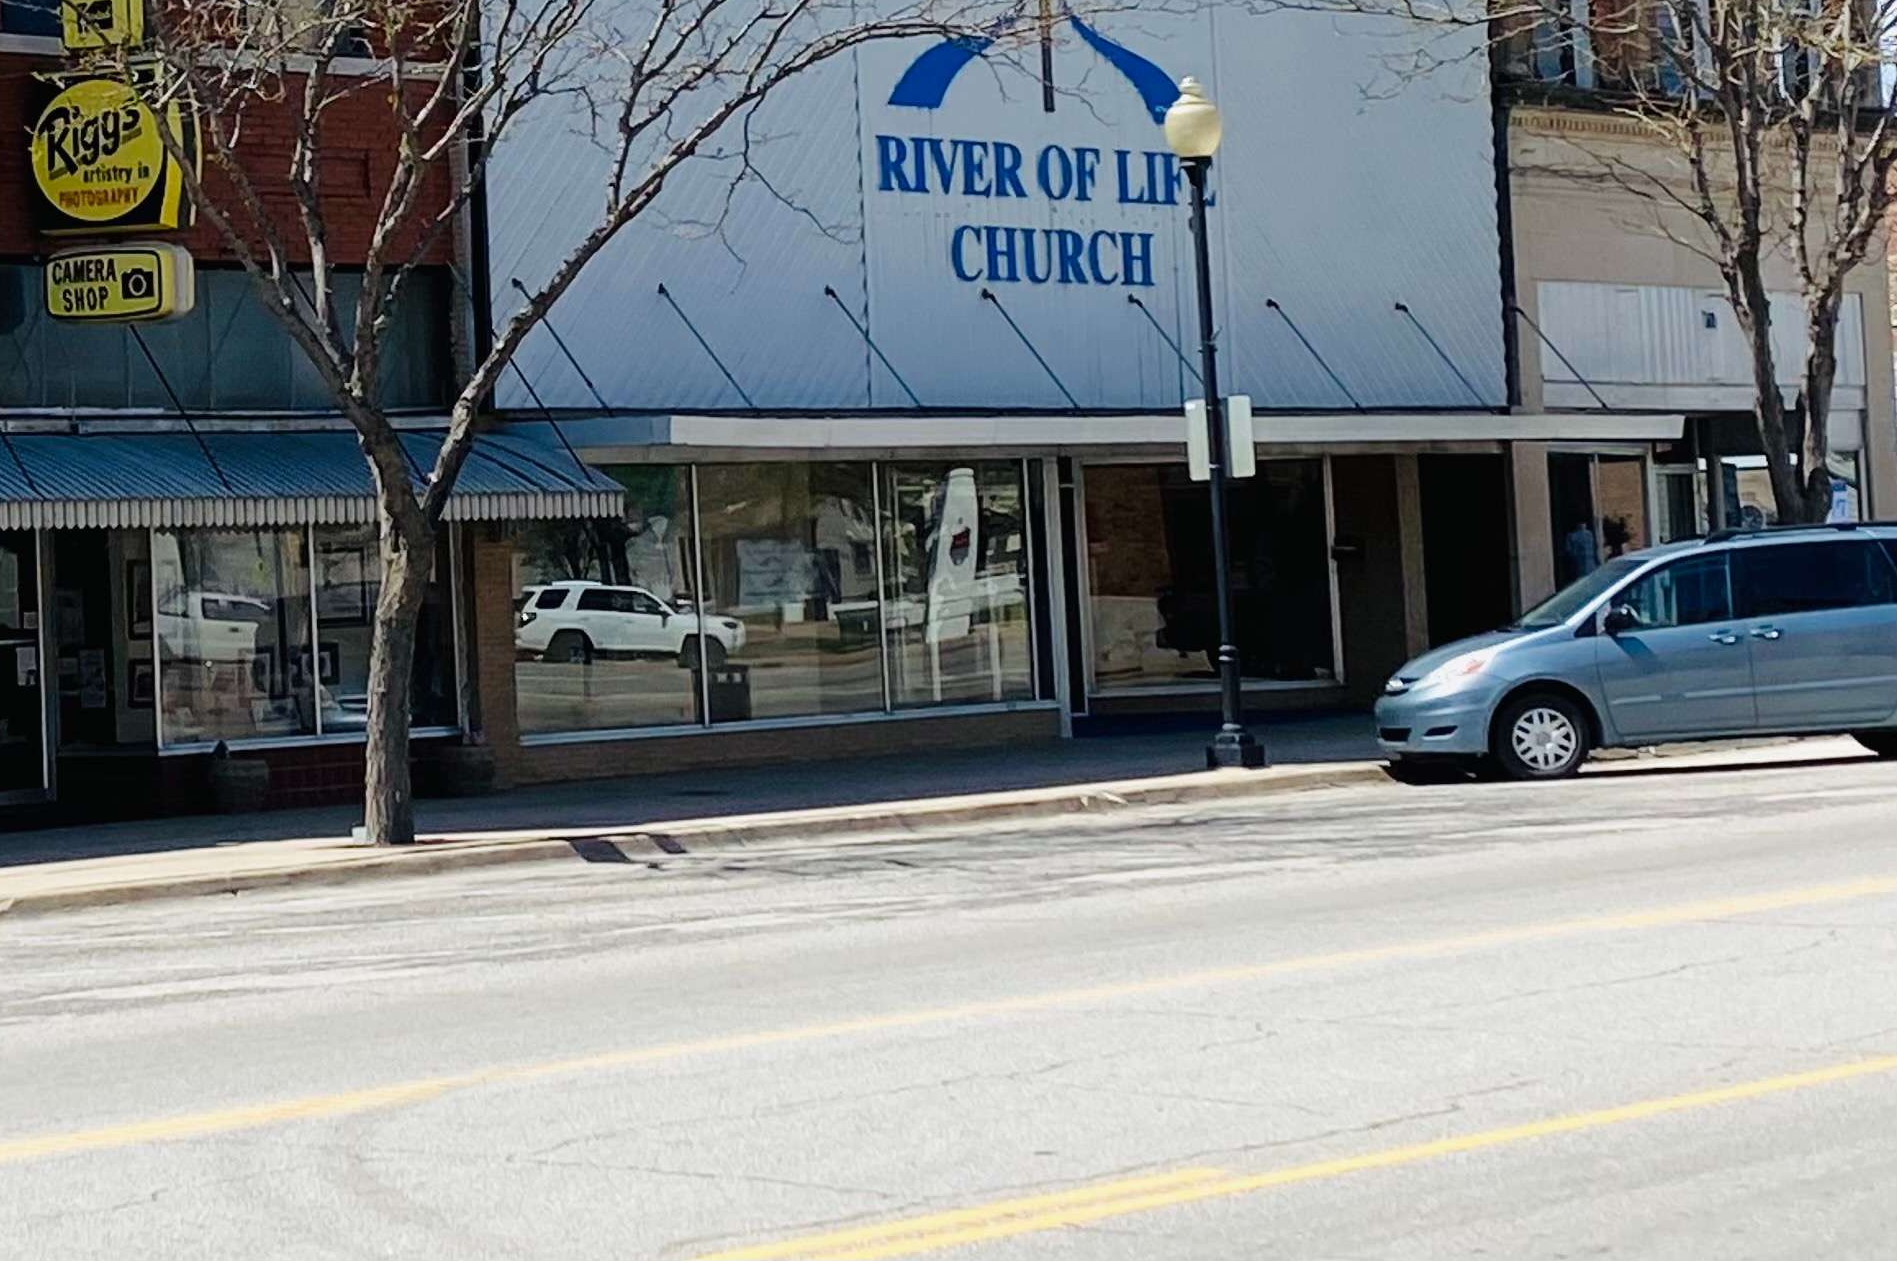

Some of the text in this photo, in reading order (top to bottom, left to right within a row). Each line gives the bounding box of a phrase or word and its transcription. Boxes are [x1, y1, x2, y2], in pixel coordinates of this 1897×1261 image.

[38, 106, 141, 178] Riggs
[83, 163, 132, 184] artistry
[876, 135, 1216, 206] RIVER OF LIF
[59, 187, 138, 208] PHOTOGRAPHY
[951, 225, 1156, 287] CHURCH
[52, 258, 117, 284] CAMERA
[63, 286, 109, 312] SHOP
